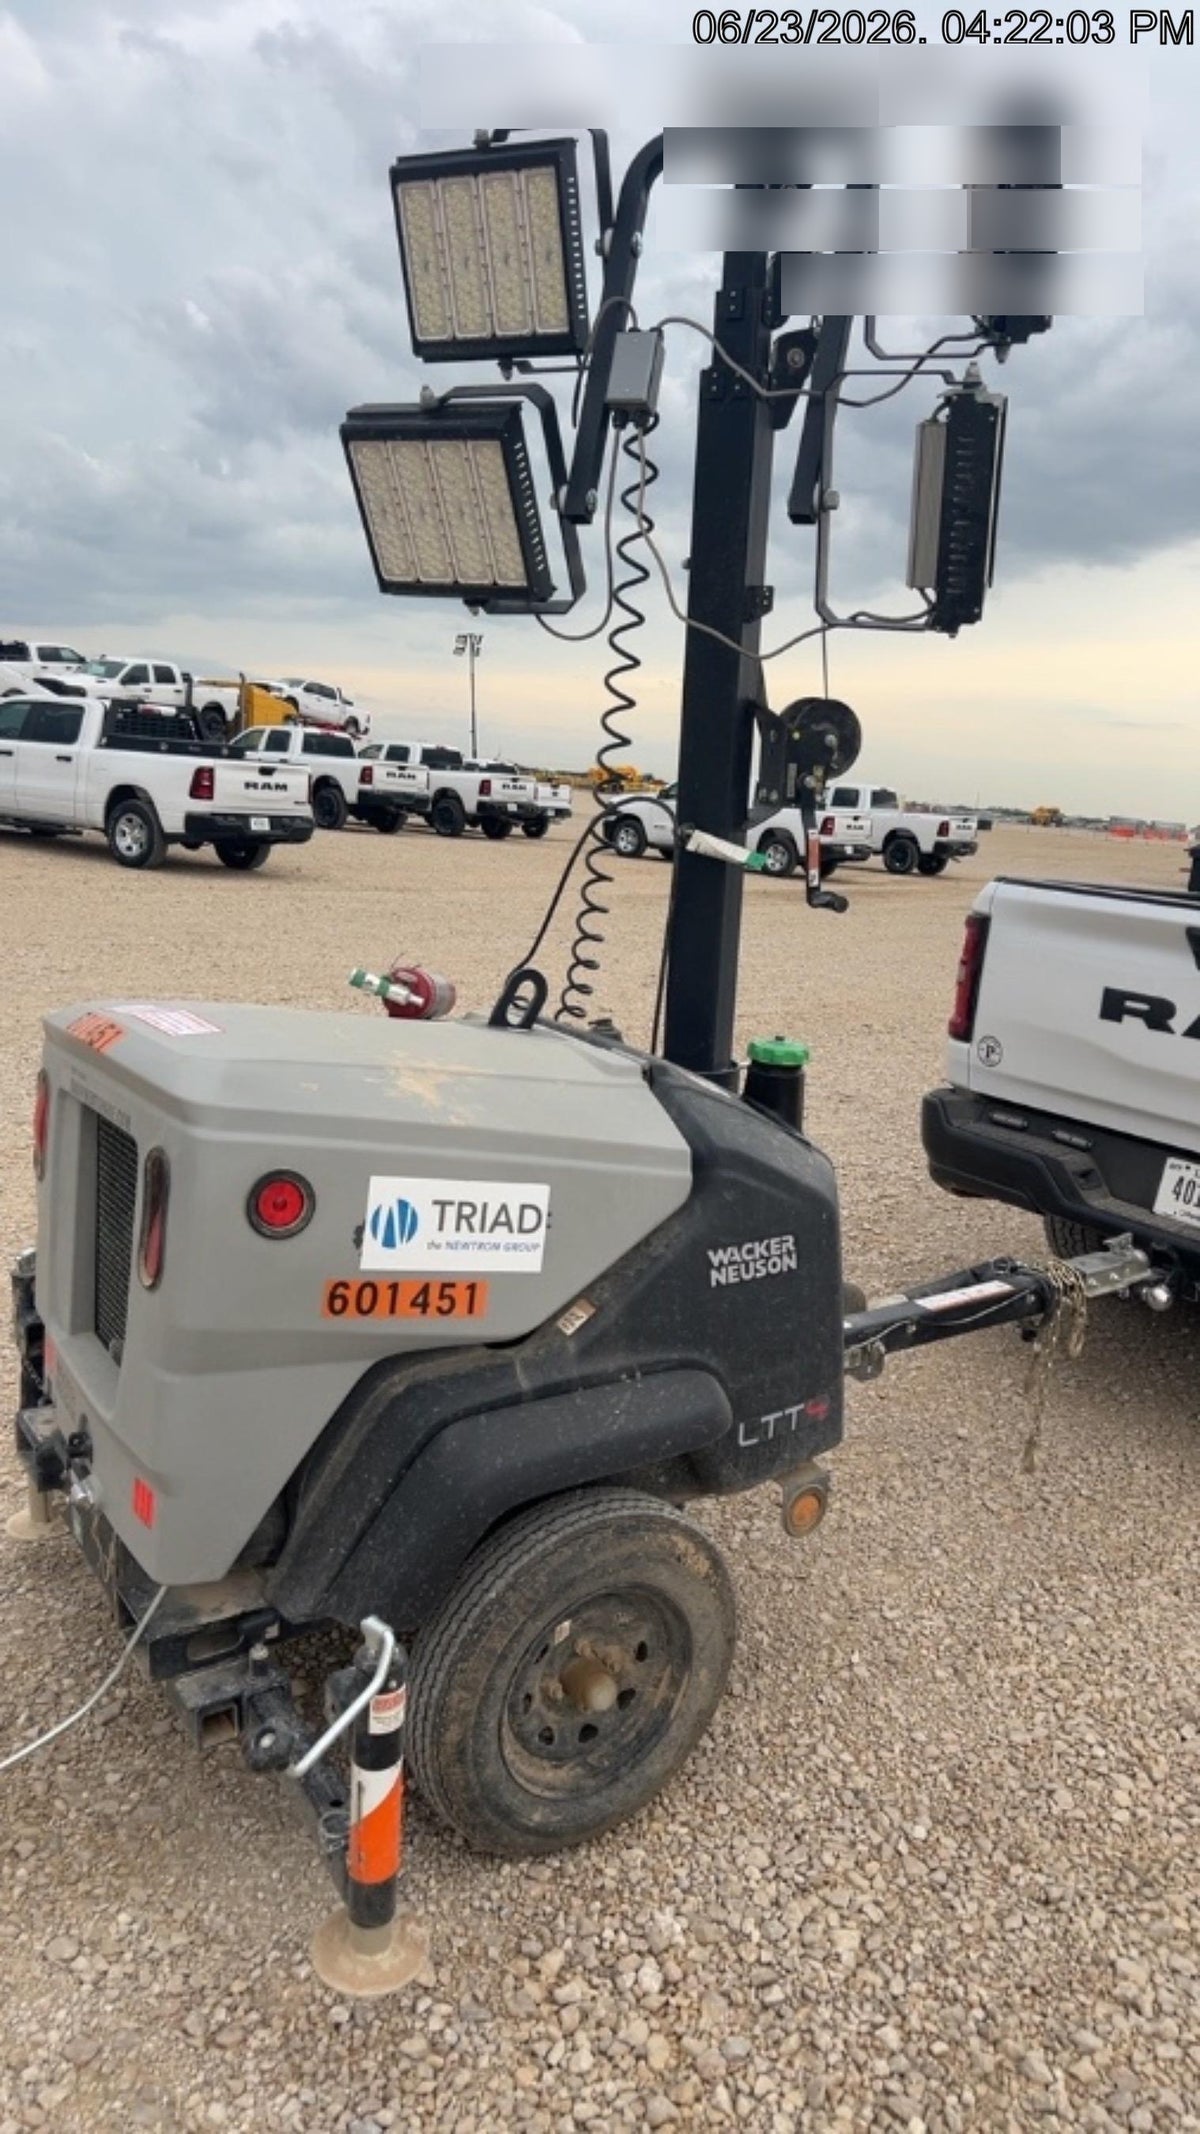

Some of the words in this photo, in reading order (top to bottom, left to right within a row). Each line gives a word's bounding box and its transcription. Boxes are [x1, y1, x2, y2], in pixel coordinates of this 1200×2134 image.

[244, 782, 288, 791] RAM
[432, 1199, 543, 1234] TRIAD
[427, 1240, 442, 1250] the
[445, 1240, 501, 1251] NEWTRON
[503, 1242, 541, 1253] GROUP
[707, 1234, 795, 1267] WACKER
[710, 1251, 798, 1288] NEUSON
[327, 1280, 478, 1316] 601451
